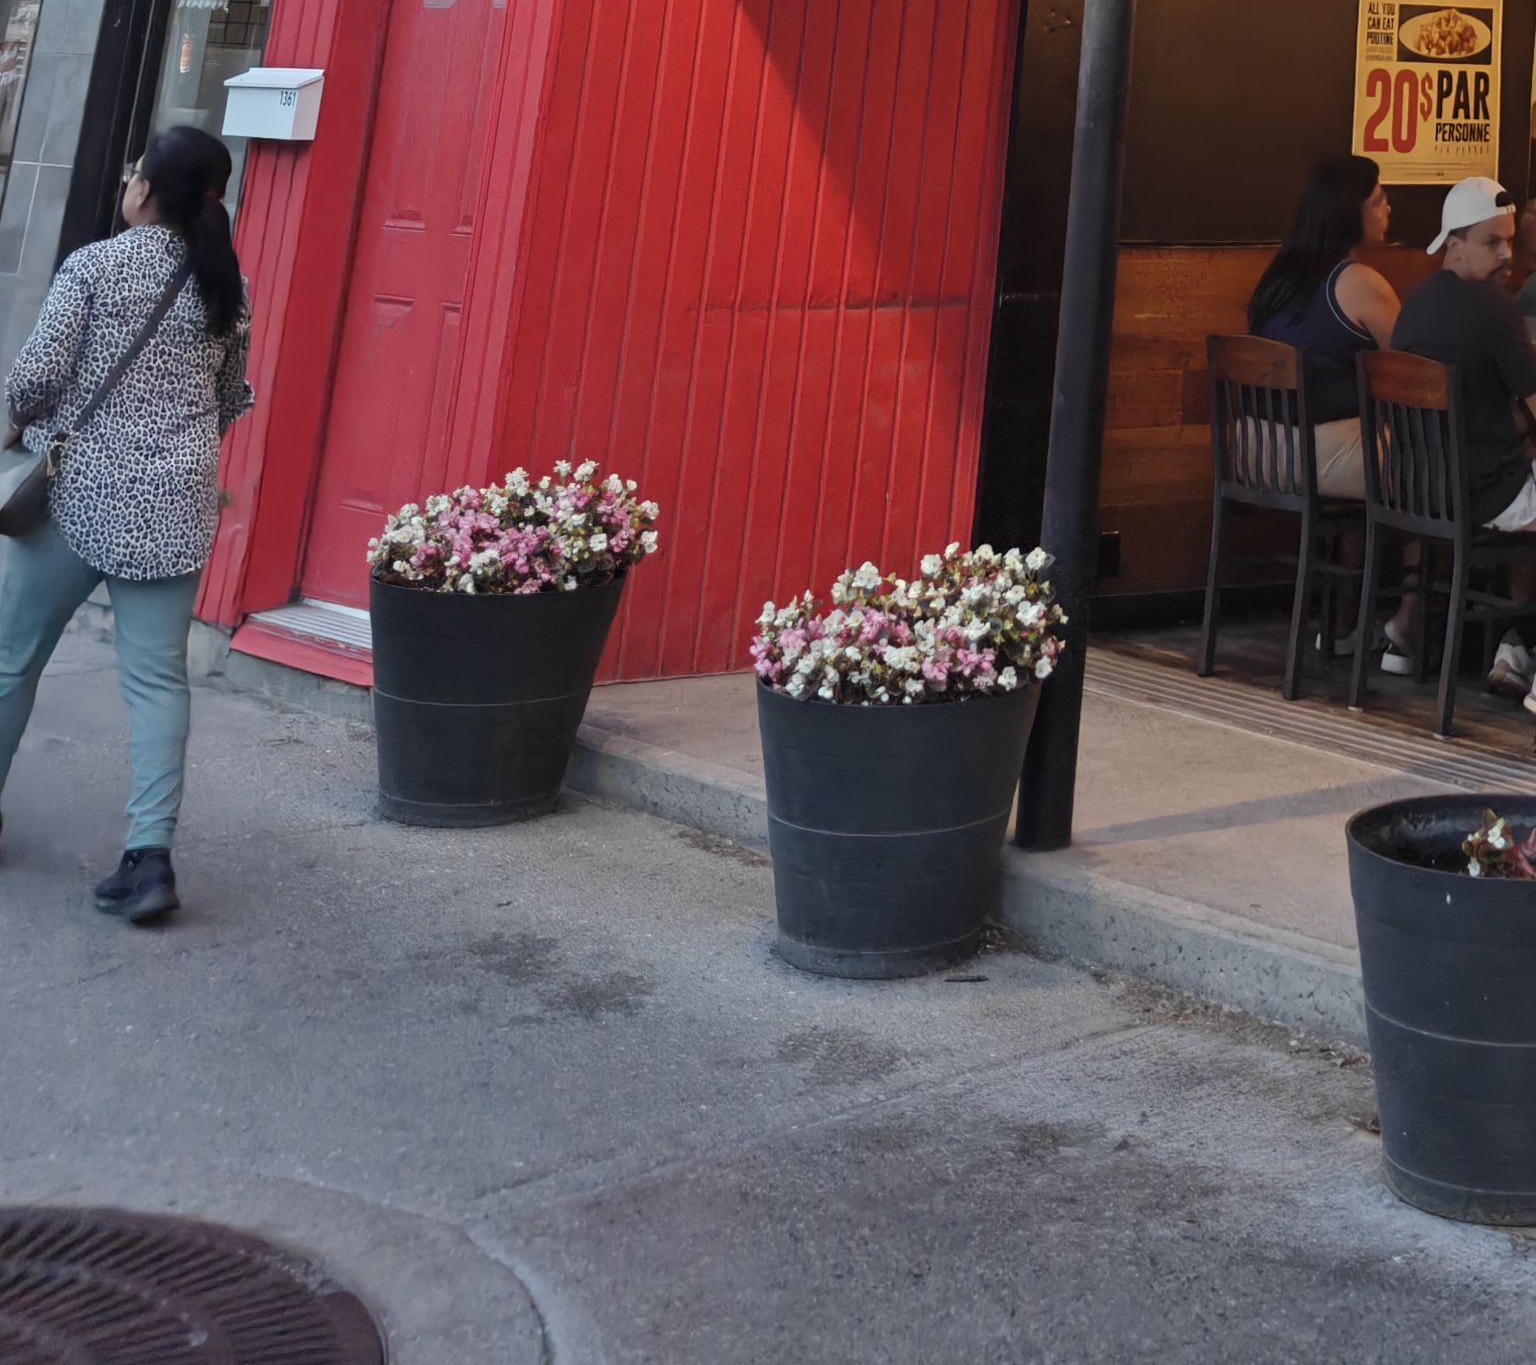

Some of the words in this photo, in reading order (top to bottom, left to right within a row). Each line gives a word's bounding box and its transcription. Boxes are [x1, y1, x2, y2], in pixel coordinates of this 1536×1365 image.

[1367, 2, 1380, 16] ALL
[1382, 17, 1394, 31] EAT
[1436, 70, 1490, 120] PAR
[1435, 122, 1490, 142] PERSONNE
